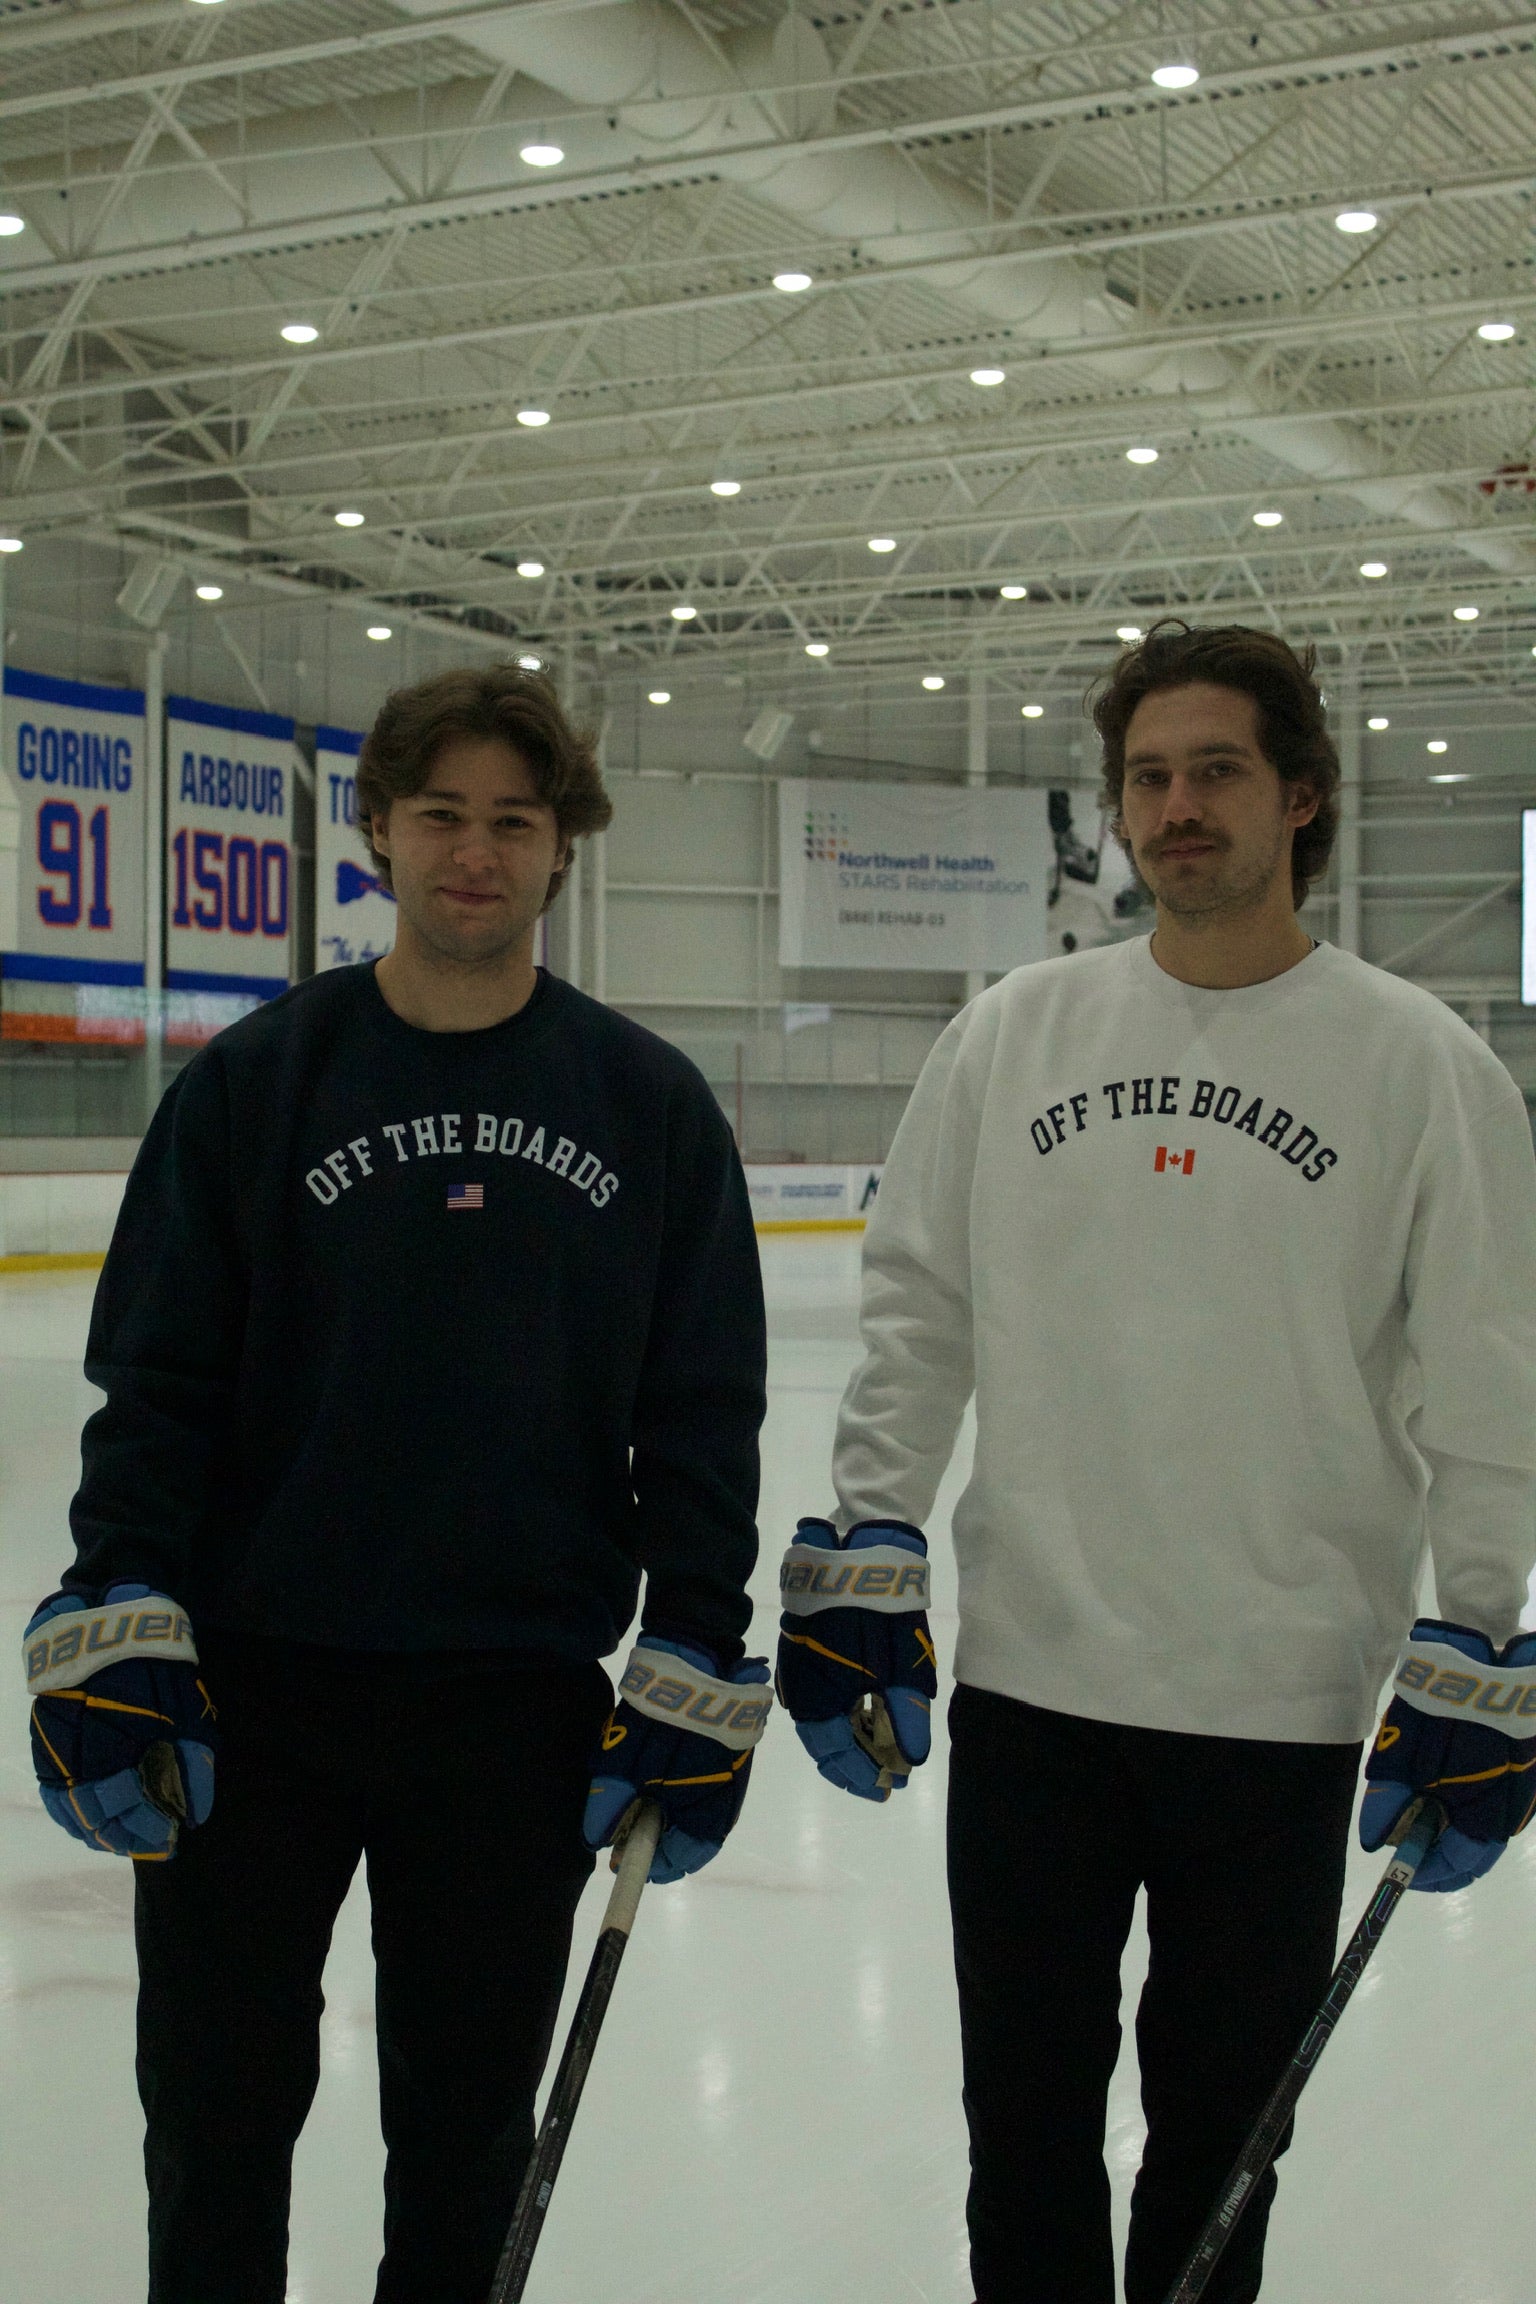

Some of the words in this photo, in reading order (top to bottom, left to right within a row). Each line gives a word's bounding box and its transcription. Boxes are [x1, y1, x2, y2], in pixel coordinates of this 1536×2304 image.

[17, 722, 132, 793] GORING
[180, 751, 284, 818] ARBOUR
[37, 799, 113, 930] 91
[171, 827, 289, 938] 1500
[838, 851, 930, 871] Northwell
[935, 854, 995, 872] Health
[838, 871, 901, 890] STARS
[906, 874, 1030, 893] Rehabilitation
[305, 1135, 374, 1206] OFF
[382, 1113, 463, 1162] THE
[473, 1112, 620, 1208] BOARDS
[1030, 1091, 1089, 1155] OFF
[1102, 1076, 1181, 1121] THE
[1188, 1079, 1338, 1182] BOARDS
[1390, 1866, 1408, 1882] 67
